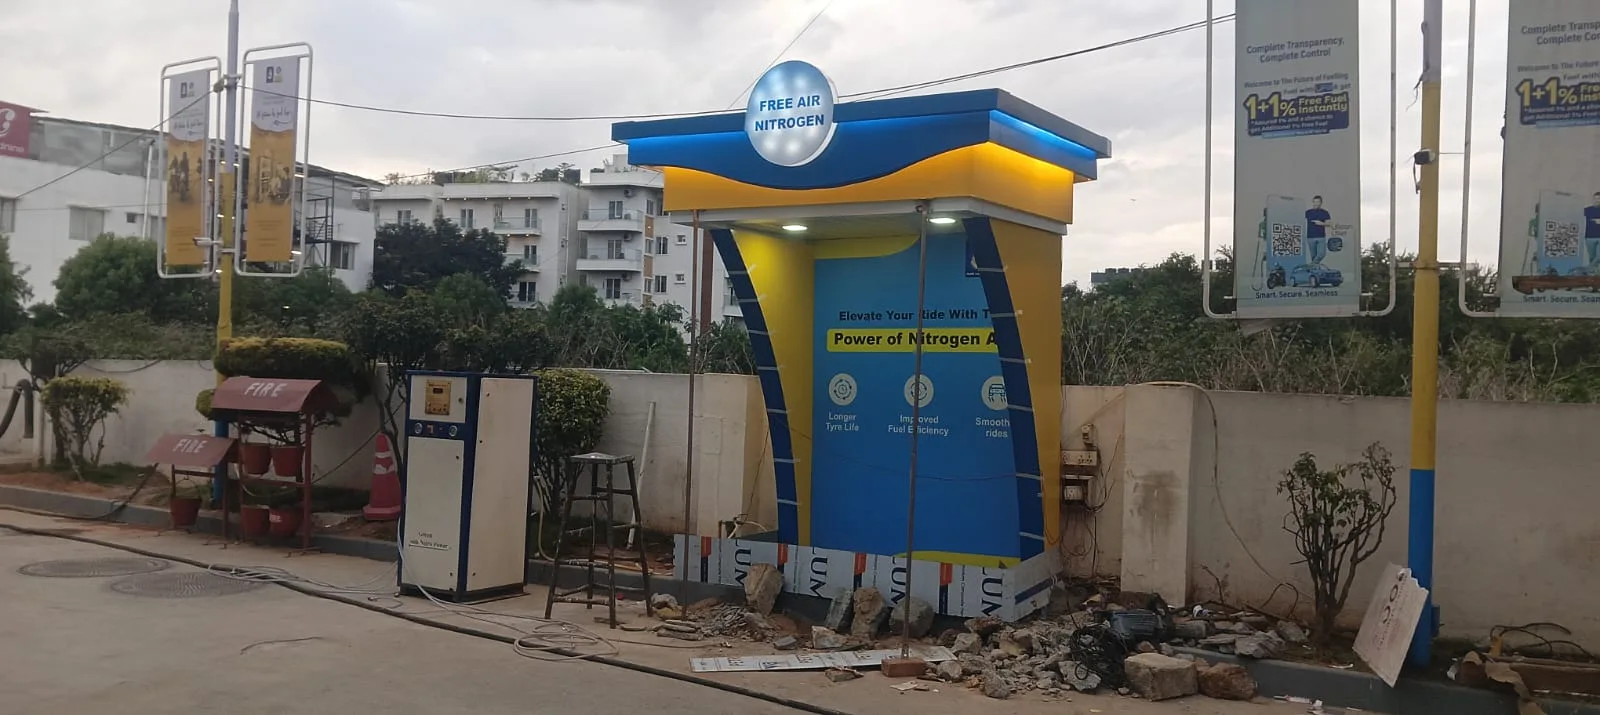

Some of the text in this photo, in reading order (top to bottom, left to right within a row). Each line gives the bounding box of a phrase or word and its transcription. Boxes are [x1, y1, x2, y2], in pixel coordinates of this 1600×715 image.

[1521, 24, 1567, 34] Complete
[1246, 37, 1344, 54] Complete Transparency,
[1536, 34, 1582, 45] Complete
[1260, 48, 1331, 63] Complete Control
[760, 95, 820, 111] FREE AIR
[1245, 94, 1296, 119] 1+1%
[1298, 94, 1347, 106] Free Fuel
[755, 114, 824, 131] NITROGEN
[839, 311, 882, 321] Elevate
[886, 310, 914, 321] Your
[949, 308, 978, 319] With
[834, 333, 882, 345] Power
[887, 332, 903, 345] of
[244, 382, 287, 398] FIRE
[828, 411, 857, 422] Longer
[825, 422, 859, 432] Tyre Life
[888, 424, 905, 433] Fuel
[986, 429, 1008, 438] rides
[172, 438, 208, 453] FIRE
